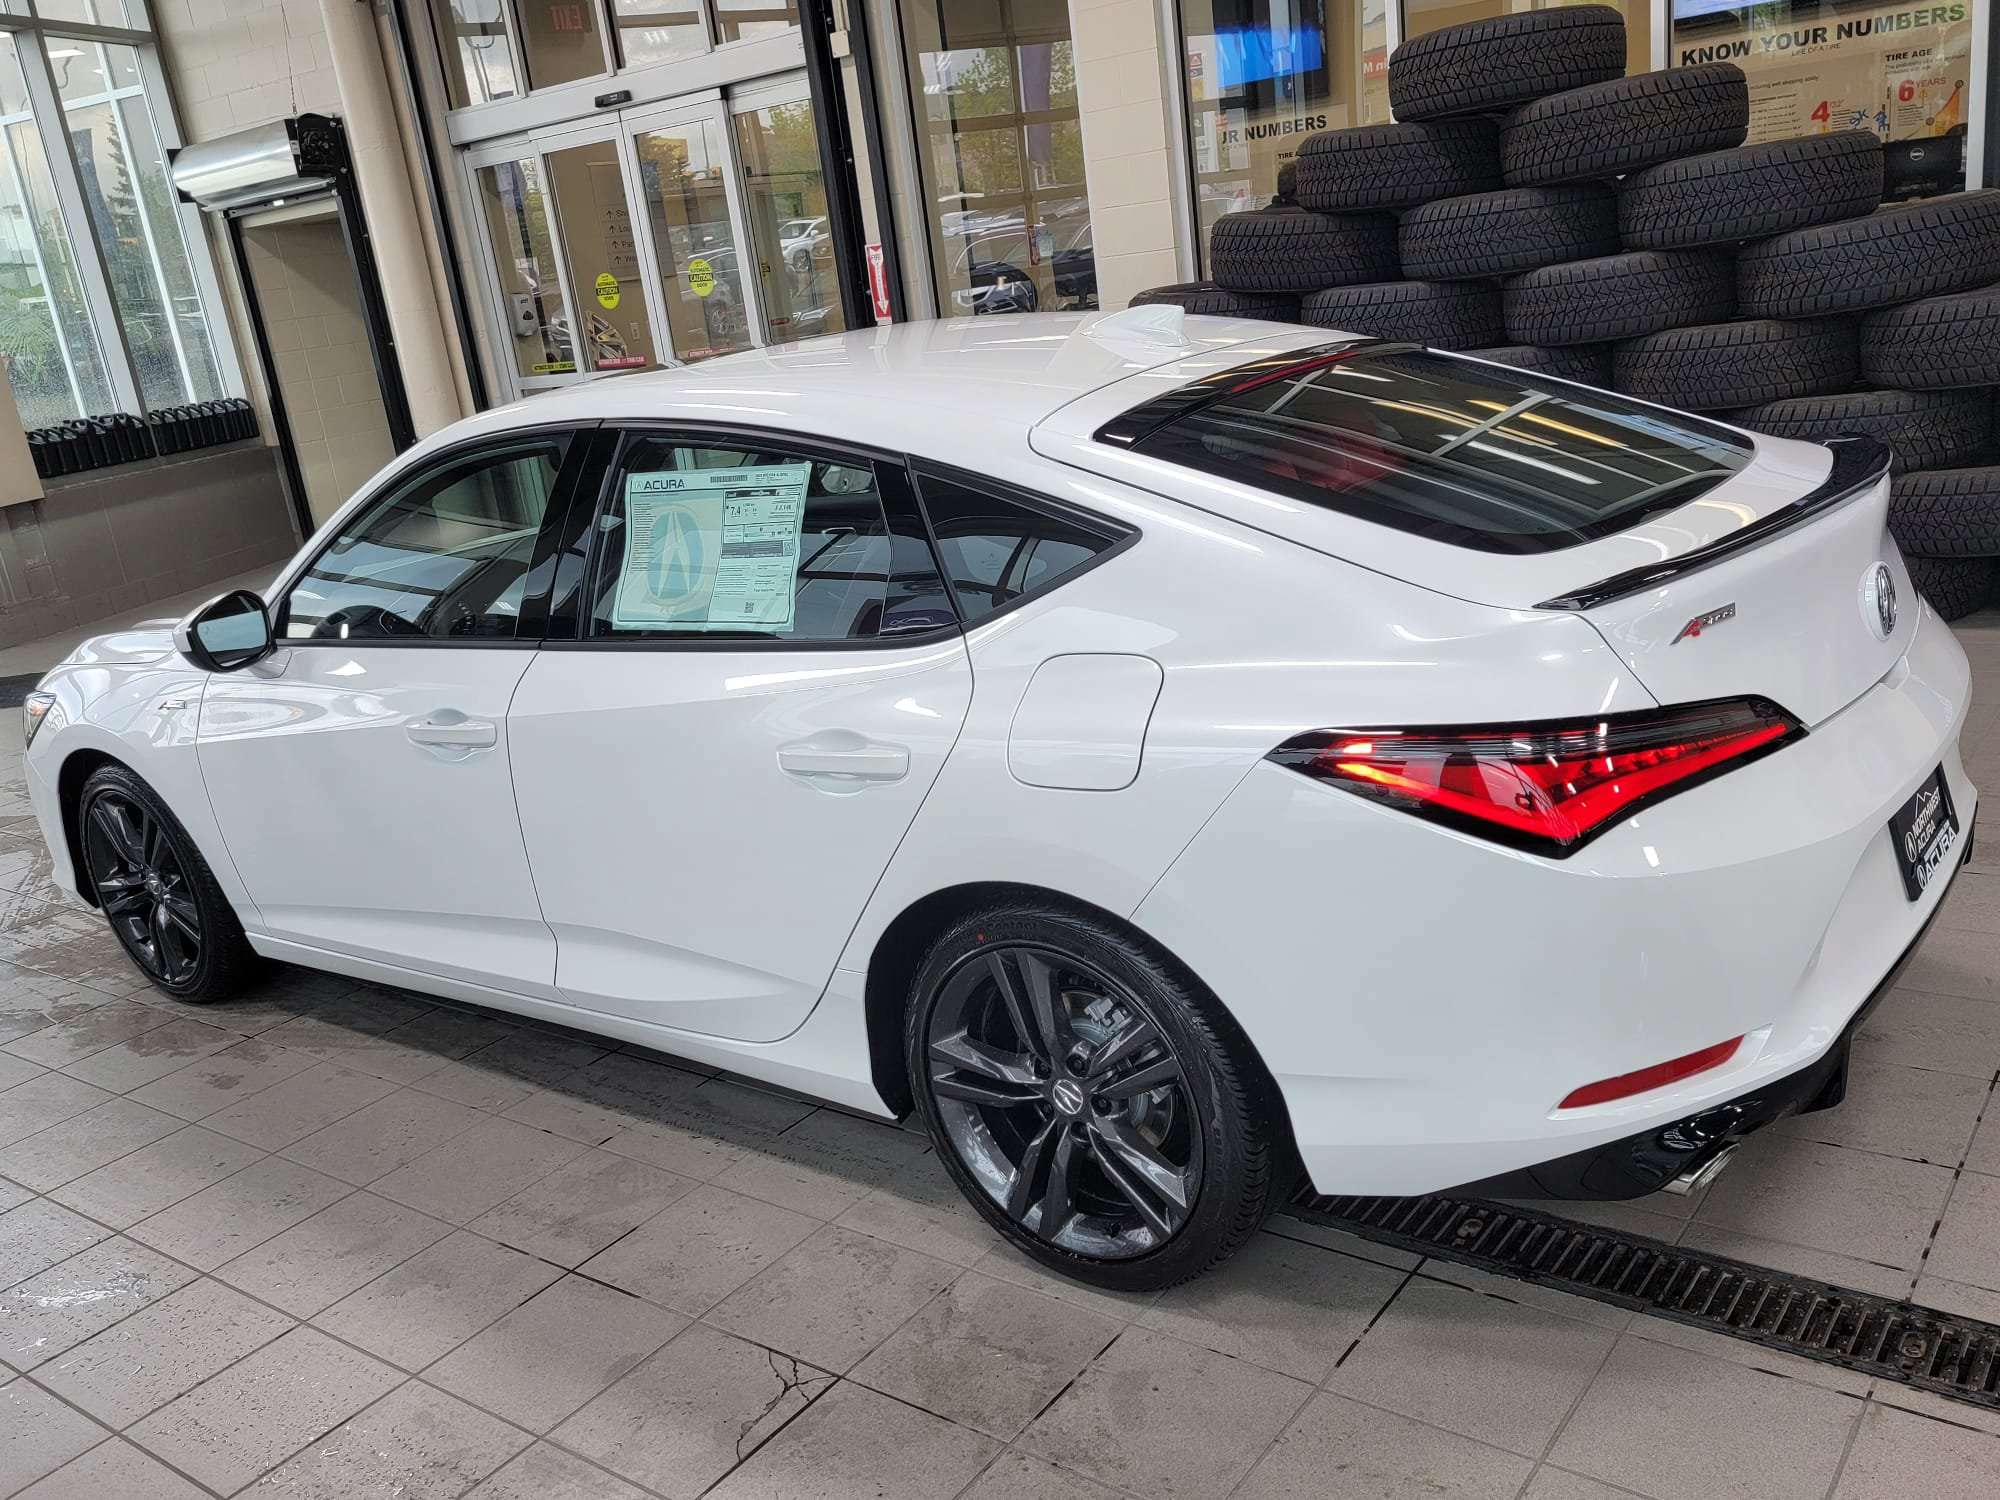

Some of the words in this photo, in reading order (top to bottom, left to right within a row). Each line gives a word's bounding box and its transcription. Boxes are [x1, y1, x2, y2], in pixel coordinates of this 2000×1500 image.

[1682, 40, 1752, 66] KNOW
[1760, 27, 1828, 51] YOUR
[1837, 3, 1966, 41] NUMBERS
[1886, 52, 1908, 62] TIRE
[1912, 48, 1933, 58] AGE
[1898, 80, 1915, 102] 6
[1916, 77, 1946, 88] YEARS
[1811, 100, 1830, 123] 4
[1245, 114, 1327, 141] NUMBERS
[1278, 151, 1294, 159] TIRE
[690, 272, 713, 281] CAUTION
[643, 479, 685, 491] ACURA
[1911, 785, 1940, 839] NORTHWEST
[1917, 820, 1937, 853] ACURA
[1924, 825, 1957, 884] ACURA
